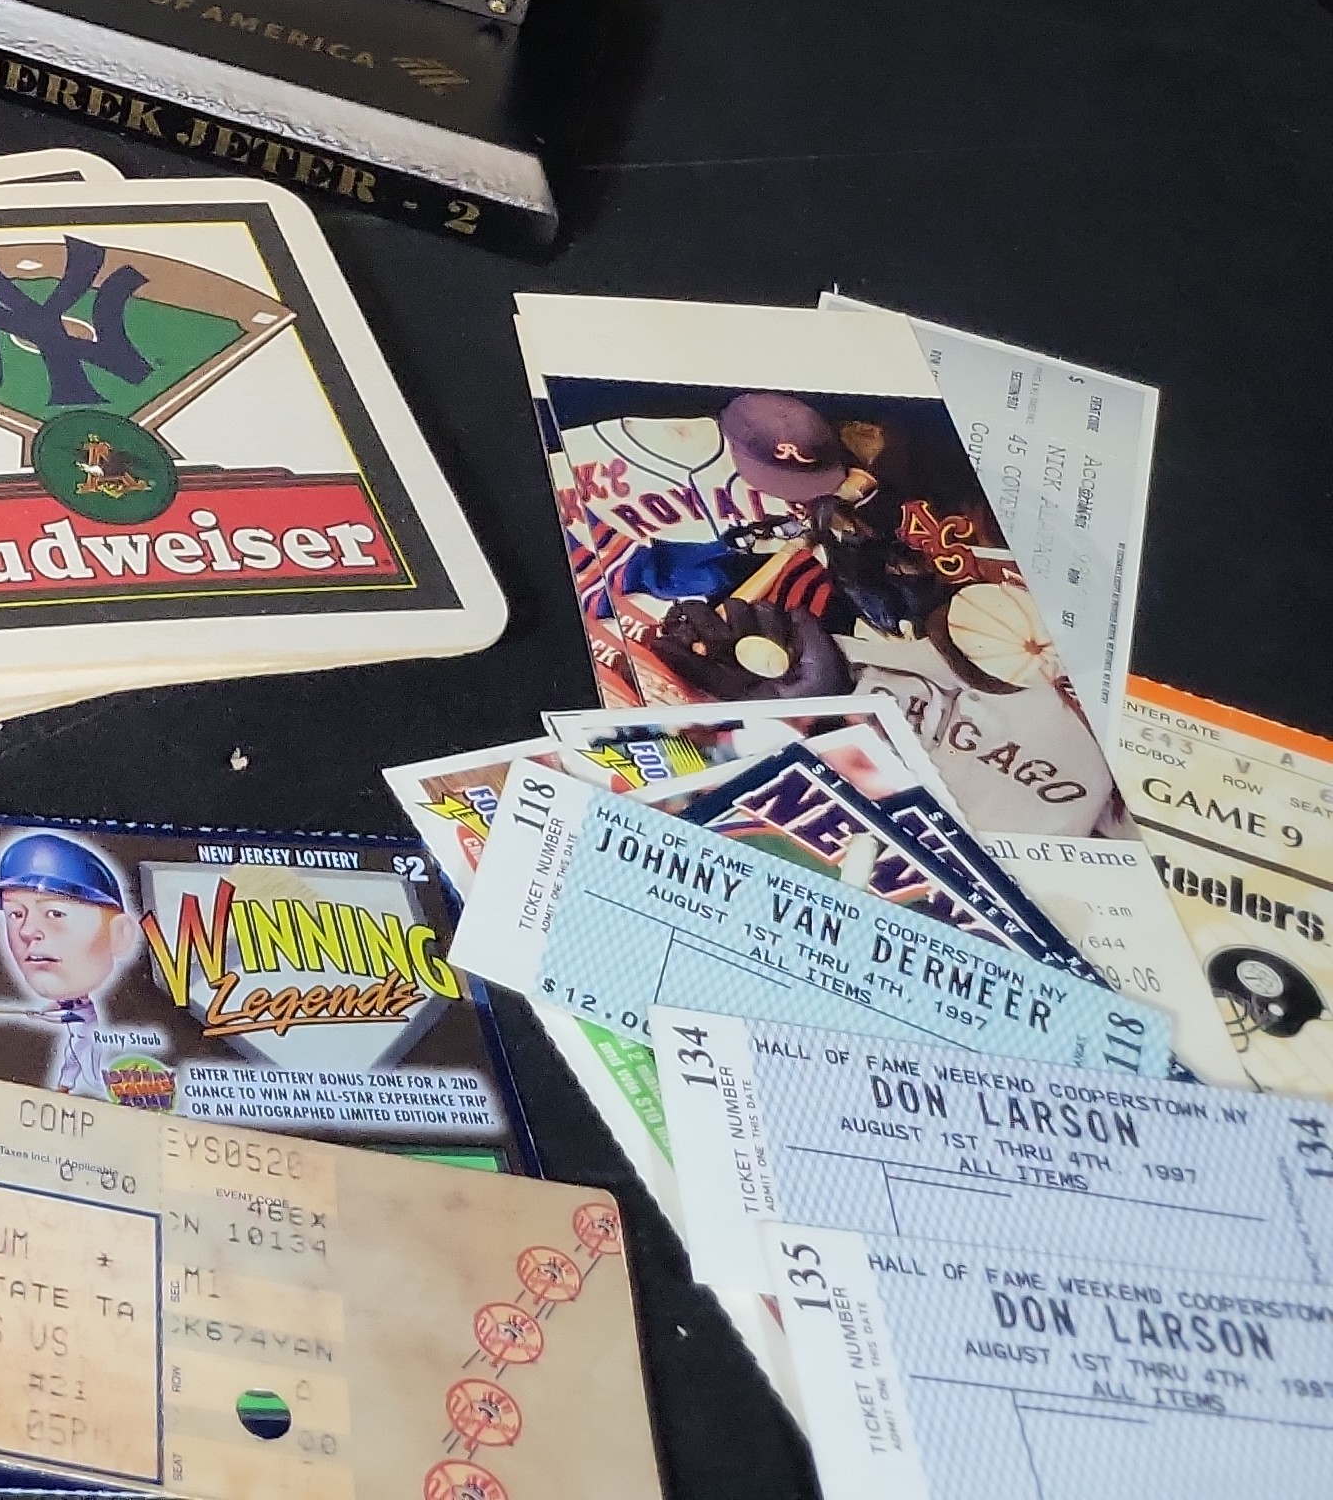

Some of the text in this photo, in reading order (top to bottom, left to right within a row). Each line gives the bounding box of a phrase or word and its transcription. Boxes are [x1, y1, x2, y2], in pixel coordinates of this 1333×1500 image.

[201, 4, 376, 70] AMERICA
[175, 117, 379, 205] JETER
[443, 200, 482, 236] 2
[1175, 718, 1222, 742] GATE
[513, 778, 557, 835] 118
[1141, 776, 1304, 849] GAME 9
[1222, 773, 1264, 796] ROW
[197, 844, 361, 870] NEW JERSEY LOTTERY
[392, 854, 430, 884] $2
[518, 817, 566, 932] TICKET NUMBER
[1025, 841, 1139, 867] of Fame
[595, 805, 648, 838] HALL
[660, 832, 689, 851] OF
[699, 847, 755, 878] FAME
[765, 871, 861, 921] WEEKEND
[1038, 982, 1070, 1005] NY
[595, 826, 1052, 1035] JOHNNY VAN DERMEER
[137, 875, 464, 1009] WINNING
[645, 884, 730, 925] AUGUST
[743, 922, 783, 948] 1ST
[795, 941, 850, 976] THRU
[933, 999, 989, 1032] 1997
[749, 946, 873, 1004] ALL ITEMS
[203, 970, 427, 1037] Legends
[93, 1030, 162, 1048] Rusty Staub
[671, 1024, 720, 1090] 134
[753, 1036, 1035, 1094] HALL FAME WEEKEND
[1102, 1011, 1146, 1076] 118
[183, 1084, 488, 1109] CHANCE WIN ALL-STAR EXPERIENCE TRIP
[189, 1066, 478, 1091] ENTER THE LOTTERY BONUS ZONE FOR 2ND
[870, 1074, 1141, 1149] DON LARSON
[18, 1098, 96, 1138] COMP
[237, 1102, 497, 1126] AUTOGRAPHED LIMITED EDITION PRINT.
[719, 1065, 761, 1215] TICKET NUMBER
[840, 1115, 1198, 1186] AUGUST THRU 1997
[1017, 1164, 1089, 1192] ITEMS
[779, 1240, 834, 1313] 135
[991, 1289, 1276, 1362] DON LARSON
[833, 1285, 887, 1455] TICKET NUMBER
